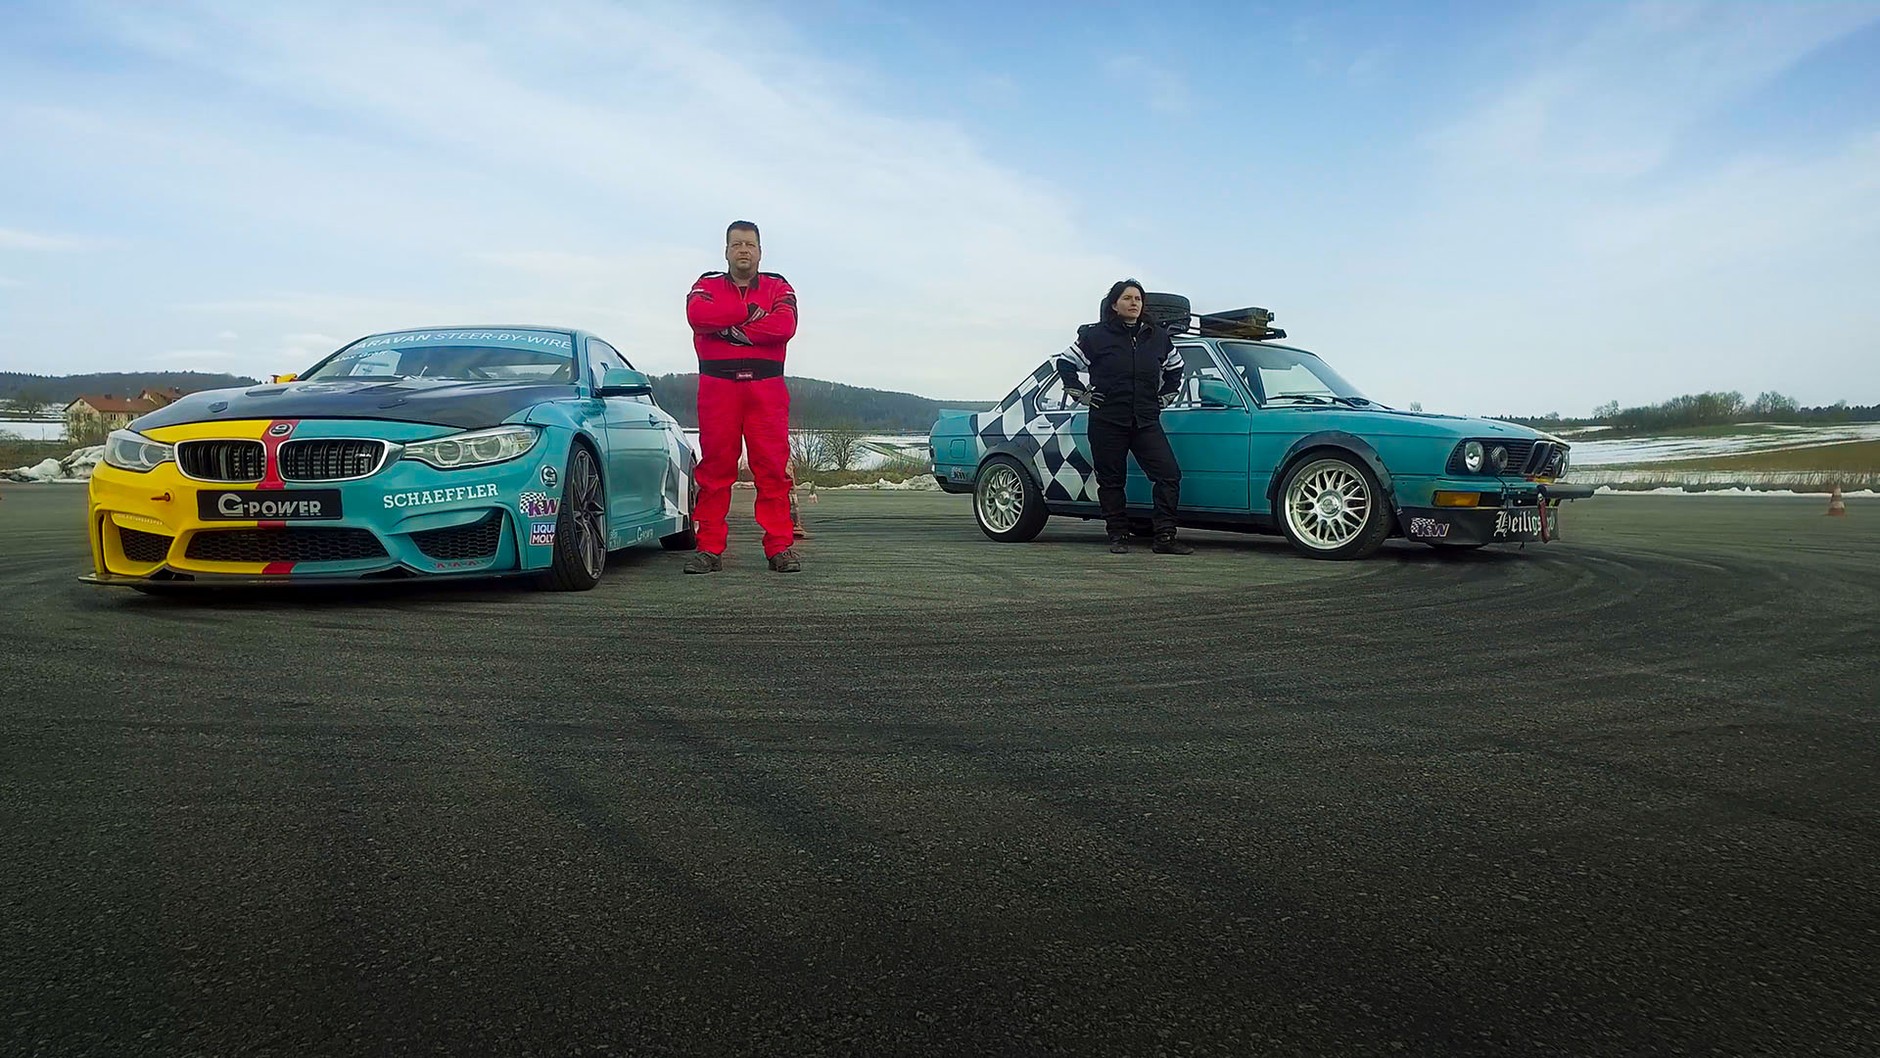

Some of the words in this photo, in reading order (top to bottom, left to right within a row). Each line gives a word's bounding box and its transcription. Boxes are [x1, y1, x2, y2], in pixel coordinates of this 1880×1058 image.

[434, 332, 572, 349] STEER-BY-WIRE
[218, 493, 321, 517] G-POWER
[383, 483, 498, 509] SCHAEFFLER
[528, 498, 560, 517] KW
[532, 534, 555, 544] MOLY
[1417, 523, 1450, 537] KW
